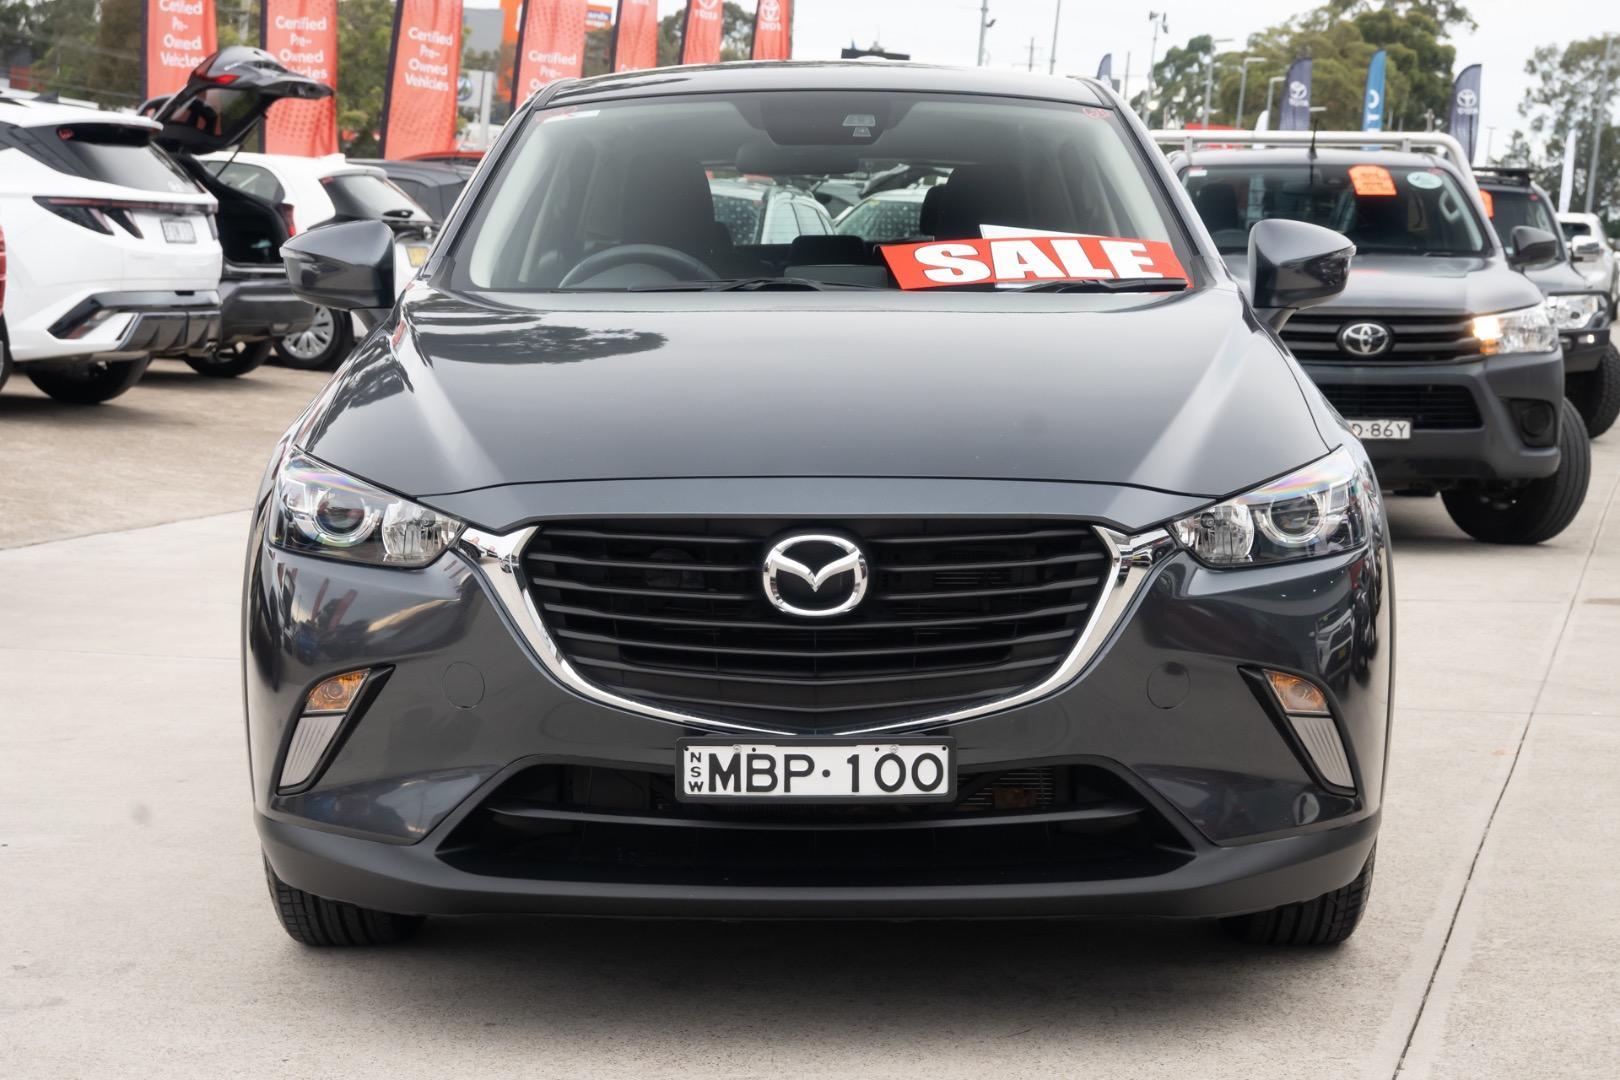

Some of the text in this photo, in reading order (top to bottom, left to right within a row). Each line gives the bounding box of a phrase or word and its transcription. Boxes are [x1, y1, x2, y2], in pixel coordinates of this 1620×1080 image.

[408, 57, 449, 76] Owned
[404, 72, 449, 91] Vehicles
[913, 239, 1164, 283] SALE
